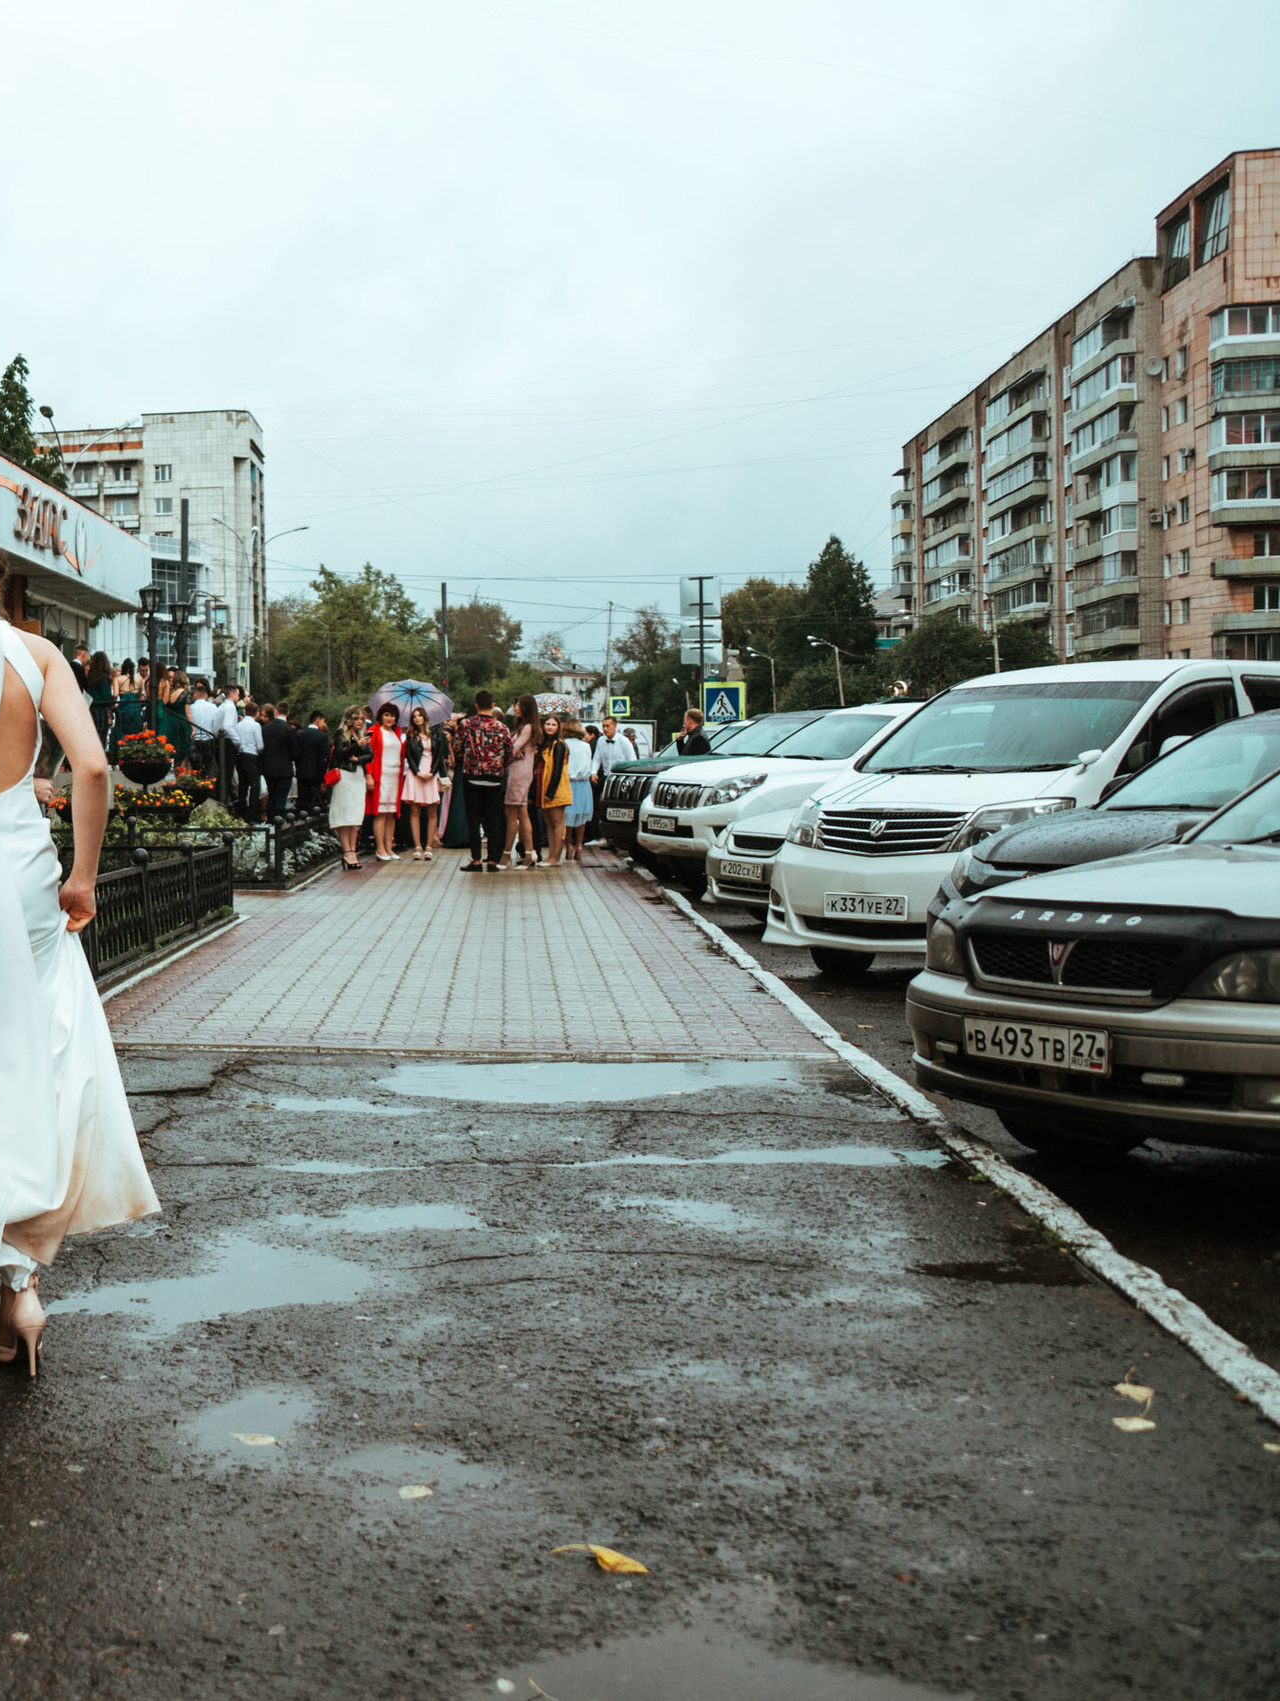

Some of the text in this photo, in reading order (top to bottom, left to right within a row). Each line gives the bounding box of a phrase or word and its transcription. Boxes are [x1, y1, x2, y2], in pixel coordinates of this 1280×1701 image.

[752, 866, 760, 877] 27
[831, 897, 899, 914] К331УЕ 27
[1009, 909, 1143, 926] ARDEO
[974, 1025, 1097, 1062] В493ТВ 27
[1071, 1057, 1090, 1068] RUS
